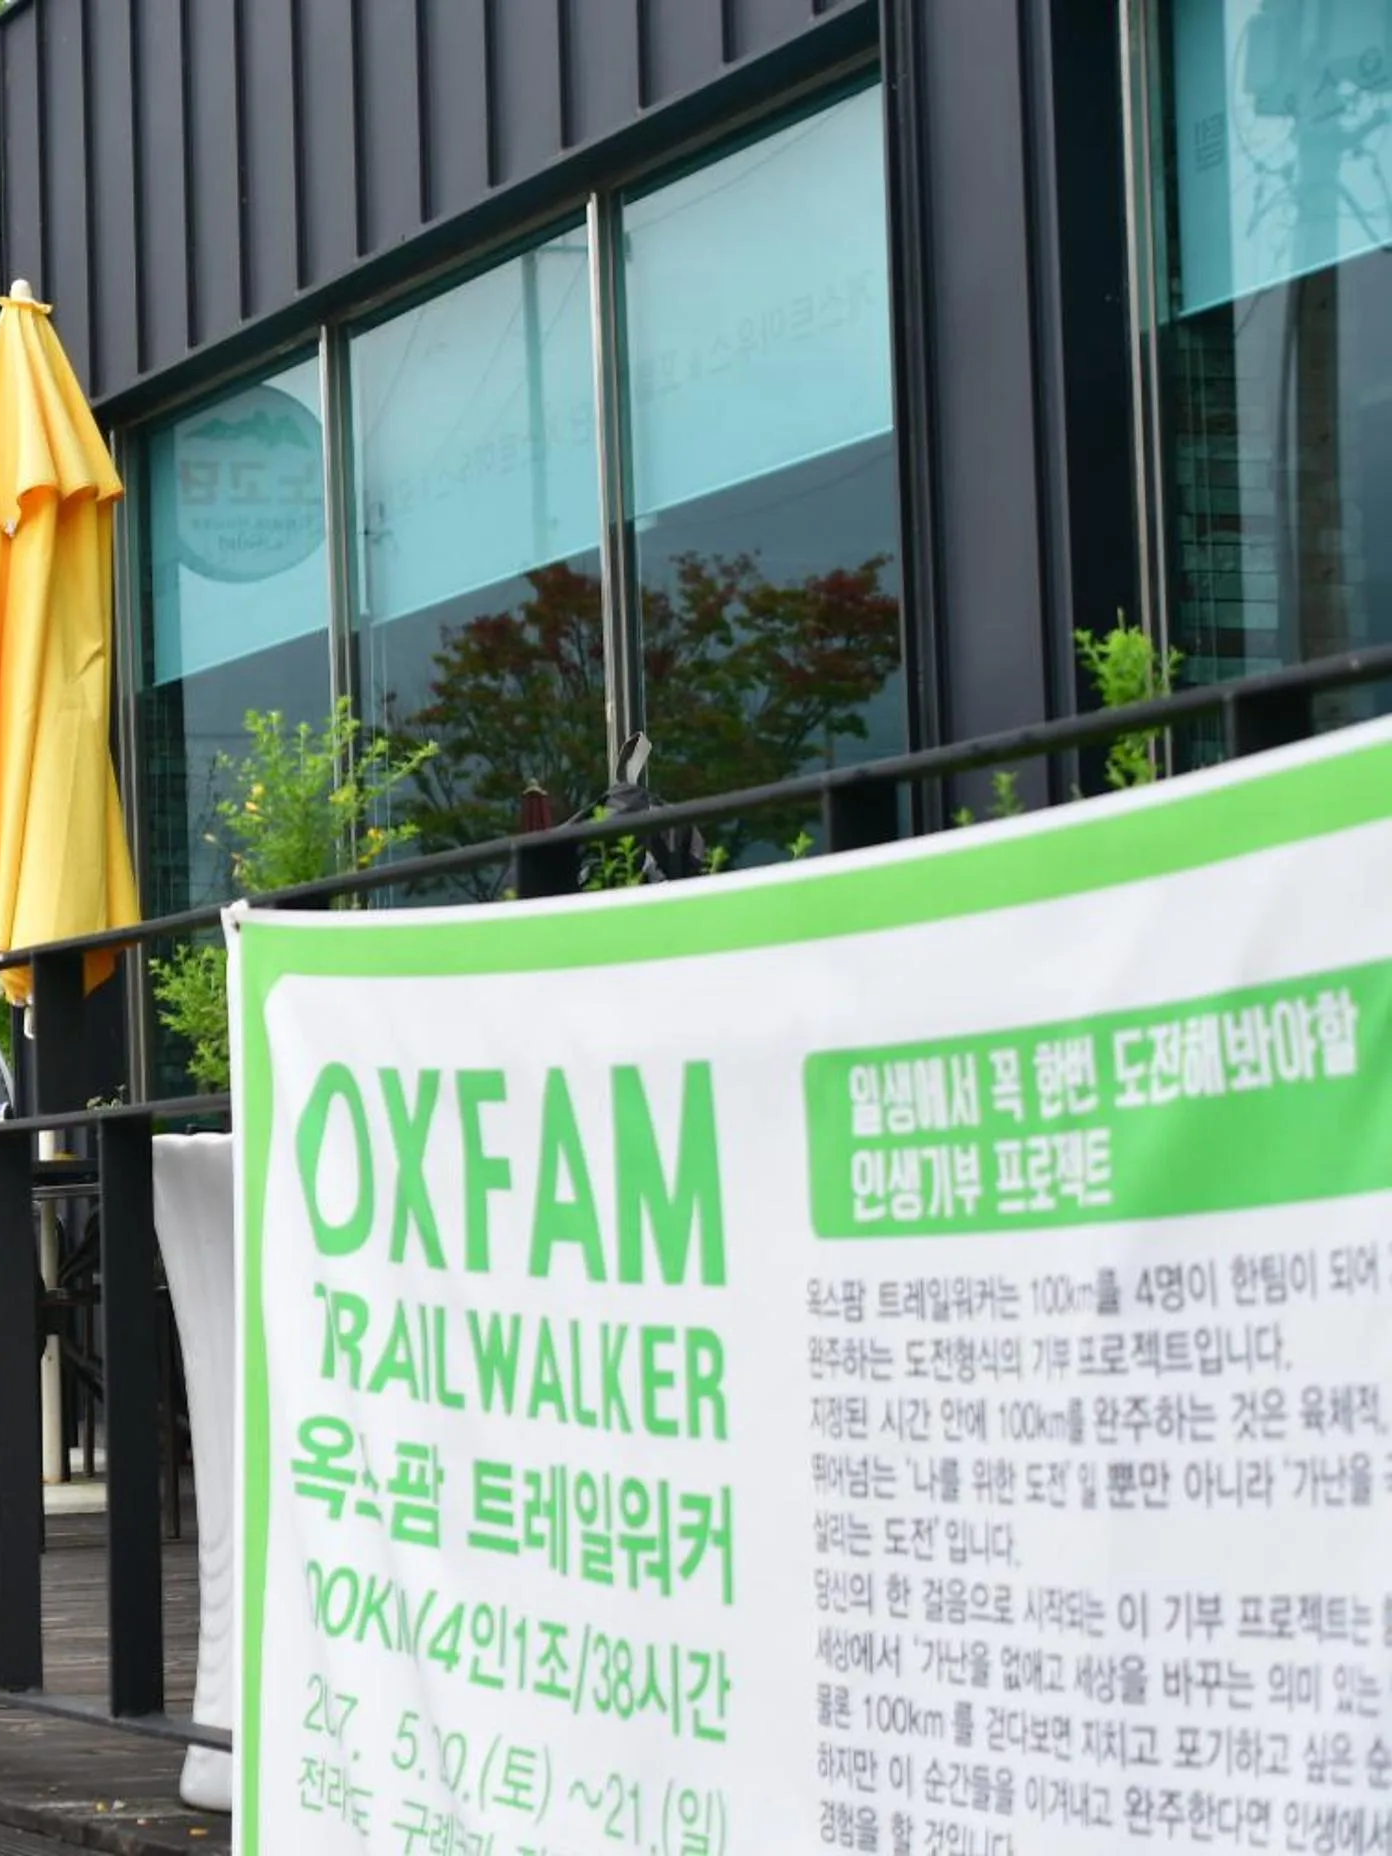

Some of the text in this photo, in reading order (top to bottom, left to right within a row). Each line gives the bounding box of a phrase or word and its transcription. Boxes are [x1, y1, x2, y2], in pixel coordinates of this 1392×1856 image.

[849, 984, 1360, 1138] 일생에서 꼭 한번 도전해봐야할
[295, 1059, 727, 1287] OXFAM
[851, 1126, 1114, 1223] 인생기부 프로젝트
[806, 1276, 867, 1324] 옥스팜
[877, 1273, 1022, 1322] 트레일워커는
[1134, 1256, 1219, 1315] 4명이
[1230, 1246, 1319, 1308] 한팀이
[1328, 1238, 1379, 1295] 되어
[312, 1281, 729, 1442] RAILWALKER
[807, 1320, 1294, 1385] 완주하는 도전형식의 기부 프로젝트입니다.
[808, 1395, 870, 1441] 지정된
[879, 1394, 932, 1442] 시간
[939, 1394, 988, 1443] 안에
[999, 1395, 1085, 1446] 100km를
[1092, 1390, 1217, 1446] 완주하는
[1230, 1383, 1290, 1441] 것은
[810, 1452, 898, 1500] 뛰어넘는
[970, 1457, 1015, 1507] 위한
[1106, 1458, 1172, 1510] 뿐만
[1183, 1454, 1275, 1512] 아니라
[466, 1457, 734, 1606] 트레일워커
[812, 1509, 873, 1558] 살리는
[812, 1566, 874, 1617] 당신의
[885, 1572, 912, 1621] 한
[922, 1577, 1015, 1625] 걸음으로
[1023, 1585, 1107, 1639] 시작되는
[1116, 1589, 1149, 1643] 이
[1163, 1589, 1225, 1644] 기부
[1236, 1591, 1374, 1647] 프로젝트는
[814, 1626, 902, 1679] 세상에서
[999, 1644, 1066, 1695] 없애고
[1073, 1652, 1148, 1706] 세상을
[1161, 1655, 1255, 1712] 바꾸는
[1267, 1660, 1323, 1715] 의미
[1332, 1663, 1381, 1718] 있는
[816, 1682, 851, 1730] 물론
[985, 1706, 1074, 1763] 걷다보면
[1080, 1716, 1163, 1772] 지치고
[1172, 1722, 1291, 1779] 포기하고
[1302, 1728, 1355, 1787] 싶은
[816, 1741, 878, 1794] 하지만
[888, 1754, 913, 1801] 이
[923, 1757, 1015, 1818] 순간들을
[1024, 1776, 1114, 1828] 이겨내고
[1123, 1784, 1272, 1848] 완주한다면
[818, 1801, 880, 1855] 경험을
